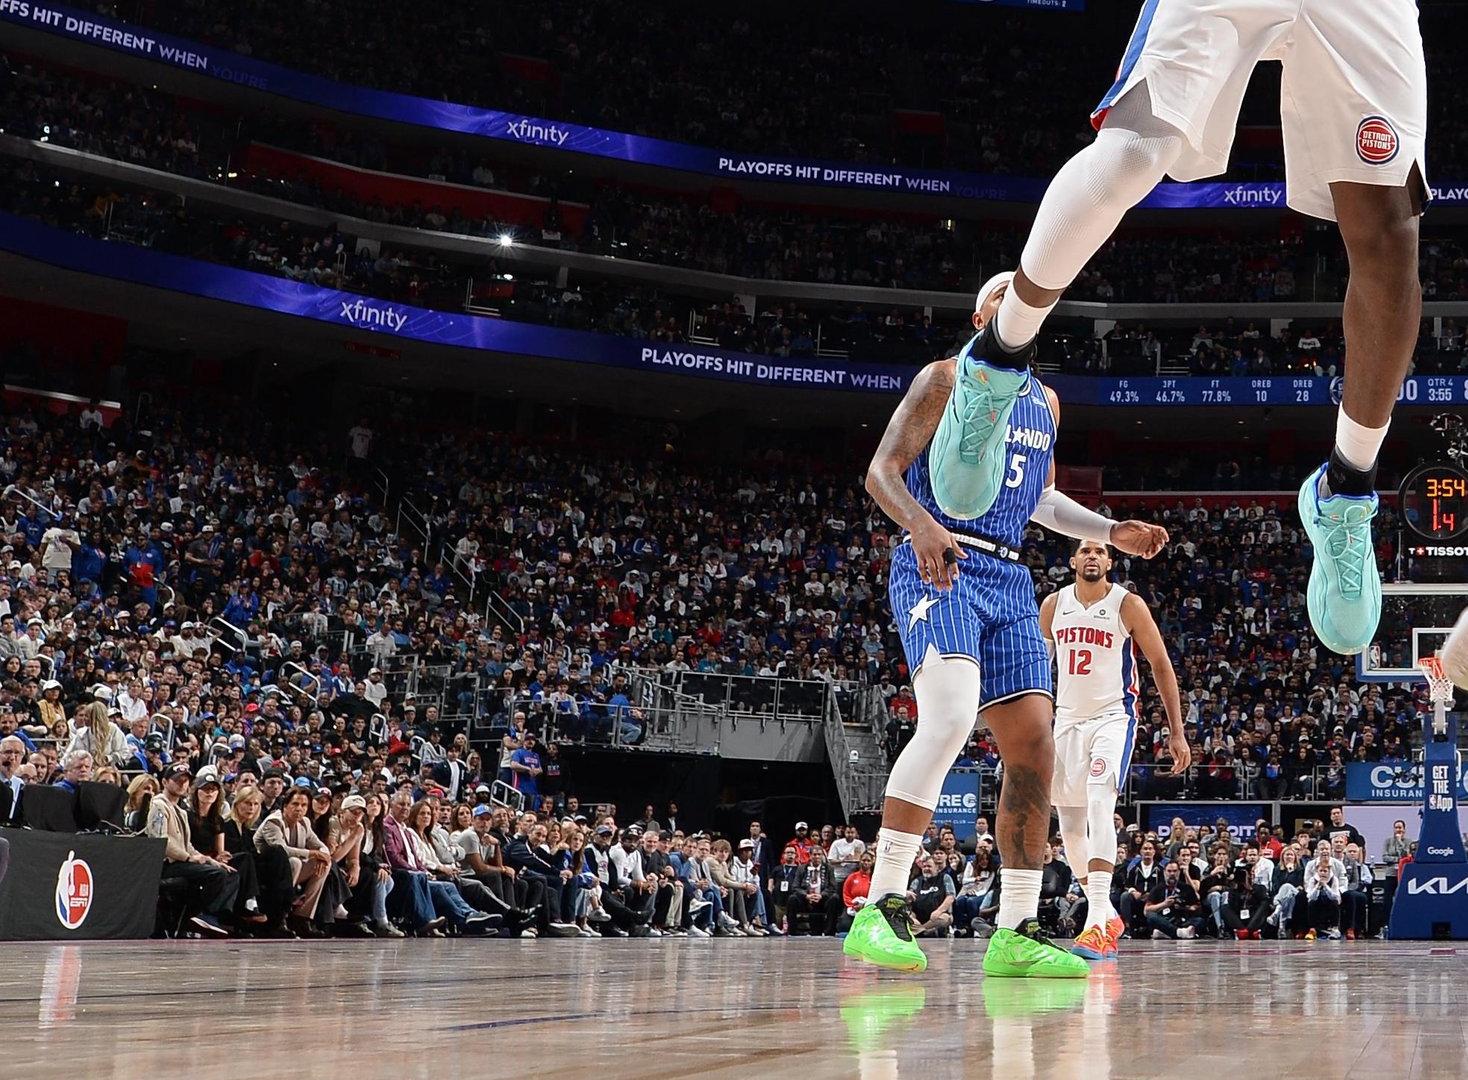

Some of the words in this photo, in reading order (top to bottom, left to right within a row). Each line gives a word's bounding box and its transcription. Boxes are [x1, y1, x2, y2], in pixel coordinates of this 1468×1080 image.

[32, 6, 63, 27] HIT
[65, 16, 156, 54] DIFFERENT
[158, 43, 208, 71] WHEN
[508, 119, 570, 146] xfinity
[1363, 130, 1391, 142] DETROIT
[1361, 139, 1391, 150] PISTONS
[719, 157, 793, 178] PLAYOFFS
[796, 165, 821, 180] HIT
[824, 168, 902, 188] DIFFERENT
[906, 177, 950, 193] WHEN
[1224, 185, 1282, 206] xfinity
[341, 300, 408, 332] xfinity
[641, 347, 723, 373] PLAYOFFS
[726, 357, 753, 376] HIT
[756, 362, 847, 386] DIFFERENT
[850, 371, 901, 390] WHEN
[1119, 379, 1129, 388] FG
[1162, 379, 1176, 388] 3PT
[1210, 379, 1220, 388] FT
[1251, 379, 1272, 388] OREB
[1292, 379, 1313, 388] DREB
[1427, 379, 1444, 387] QTR
[1109, 390, 1139, 403] 49.3%
[1155, 390, 1185, 403] 46.7%
[1201, 390, 1231, 403] 77.8%
[1255, 390, 1268, 403] 10
[1295, 390, 1309, 402] 28
[1428, 388, 1453, 402] 3:55
[1005, 453, 1027, 489] 5
[1426, 478, 1466, 498] 3:54
[1056, 626, 1115, 649] PISTONS
[1069, 649, 1092, 675] 12
[1432, 765, 1449, 779] GET
[1371, 789, 1423, 798] INSURAN
[1432, 780, 1449, 794] THE
[1436, 794, 1453, 812] App
[1427, 846, 1454, 857] Google
